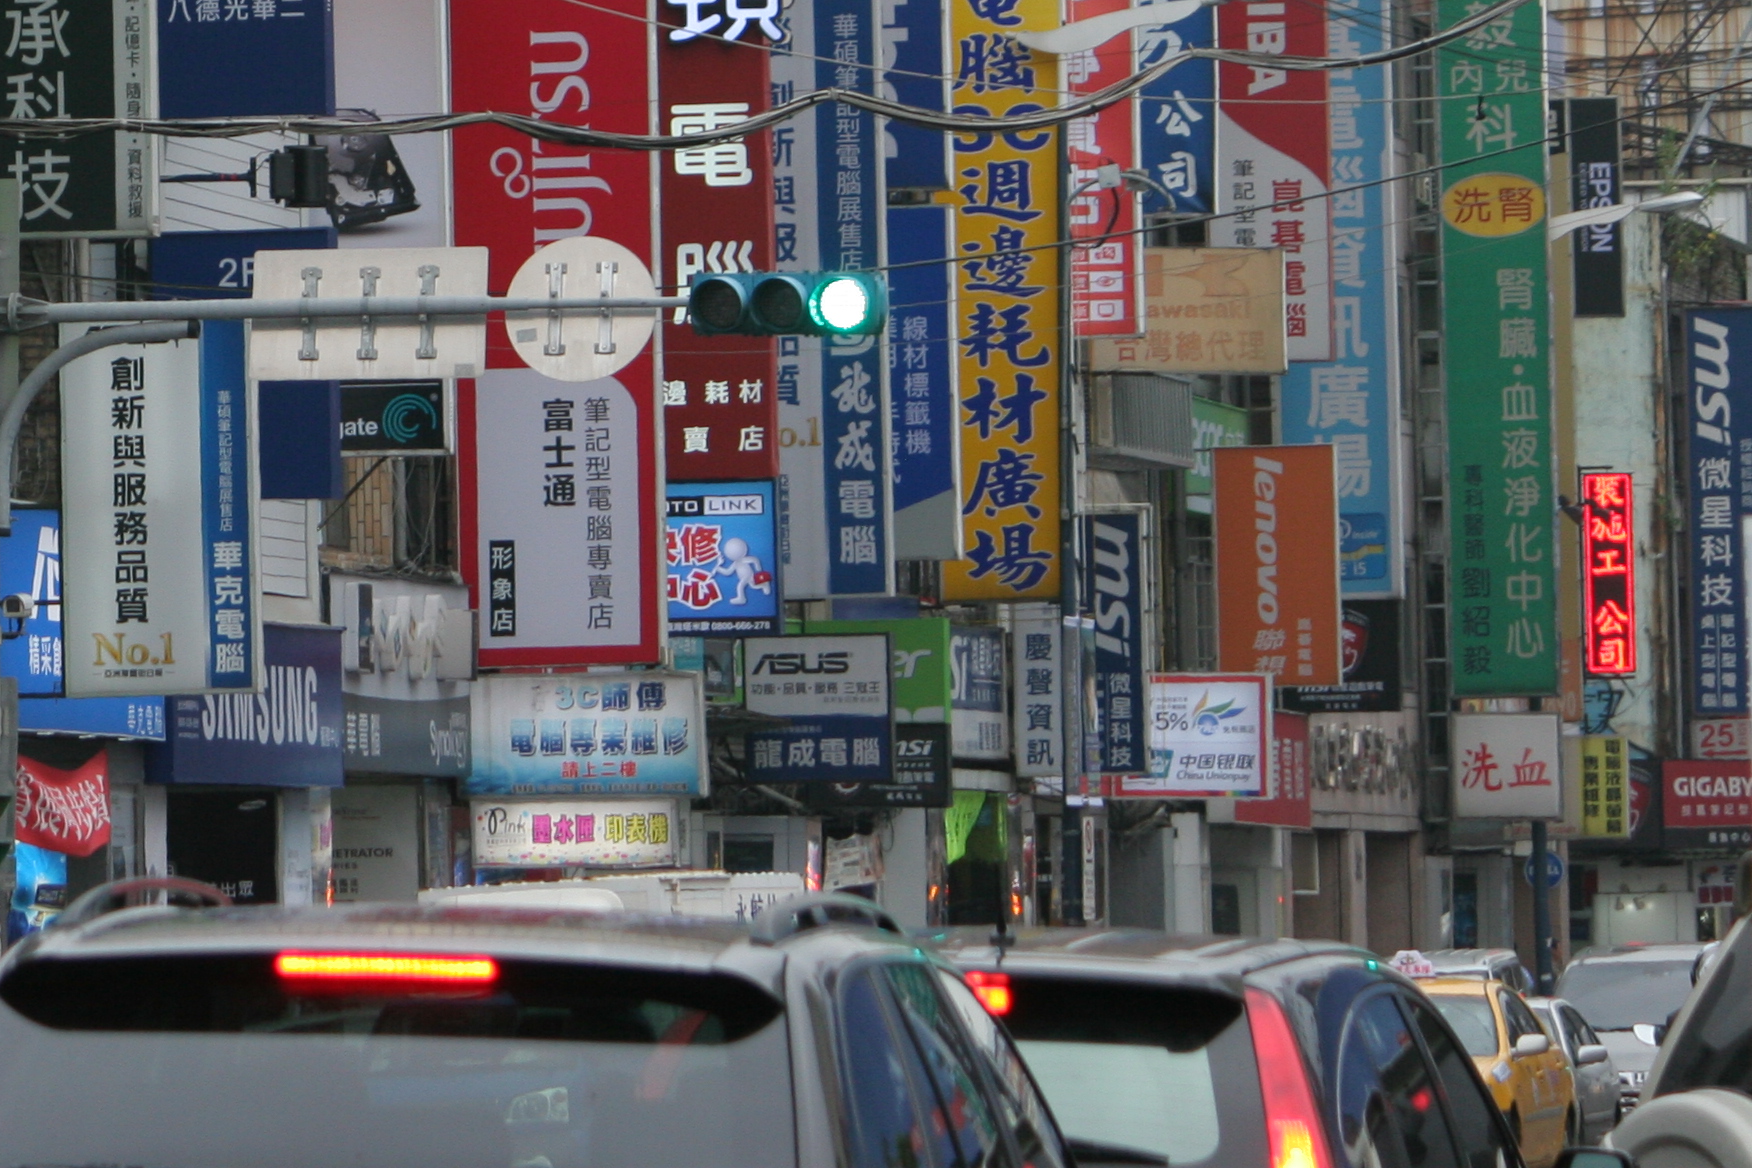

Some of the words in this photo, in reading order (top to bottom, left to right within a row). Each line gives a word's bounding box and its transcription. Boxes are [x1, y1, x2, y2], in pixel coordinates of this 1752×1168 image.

[529, 29, 613, 252] UJISU
[1453, 186, 1535, 224] 洗腎
[1114, 331, 1265, 364] 台灣總代理
[902, 315, 932, 456] 線材標籤機
[1694, 317, 1733, 449] msi
[217, 389, 234, 533] 華碩筆記型電腦展售店
[542, 397, 576, 508] 富士通
[779, 416, 823, 448] o.1
[110, 355, 149, 625] 創新與服務品質
[583, 396, 614, 631] 筆記型電腦專賣店
[667, 500, 698, 513] TO
[708, 499, 758, 512] LINK
[1253, 455, 1284, 625] lenovo
[1698, 457, 1734, 608] 微星科技
[212, 540, 245, 674] 華克電腦
[491, 546, 514, 632] 形象店
[1094, 520, 1131, 658] msi
[92, 632, 176, 668] No.1
[1461, 566, 1492, 675] 劉紹毅
[1595, 599, 1628, 671] 公司
[753, 652, 851, 676] ASUS
[844, 680, 880, 695] 三冠王
[202, 663, 318, 747] SAMSUNG
[555, 681, 667, 711] 3C師傅
[1024, 632, 1054, 767] 慶聲資訊
[1109, 672, 1132, 768] 微星科技
[1155, 709, 1189, 732] 5%
[509, 718, 690, 756] 電腦專業維修
[753, 738, 881, 769] 龍成電腦
[1178, 753, 1256, 770] 中国银联
[1700, 723, 1735, 749] 25
[561, 760, 638, 779] 請上二樓
[1176, 769, 1203, 782] China
[1461, 742, 1552, 792] 洗血
[532, 813, 596, 845] 墨水匣
[603, 813, 669, 845] 印表機
